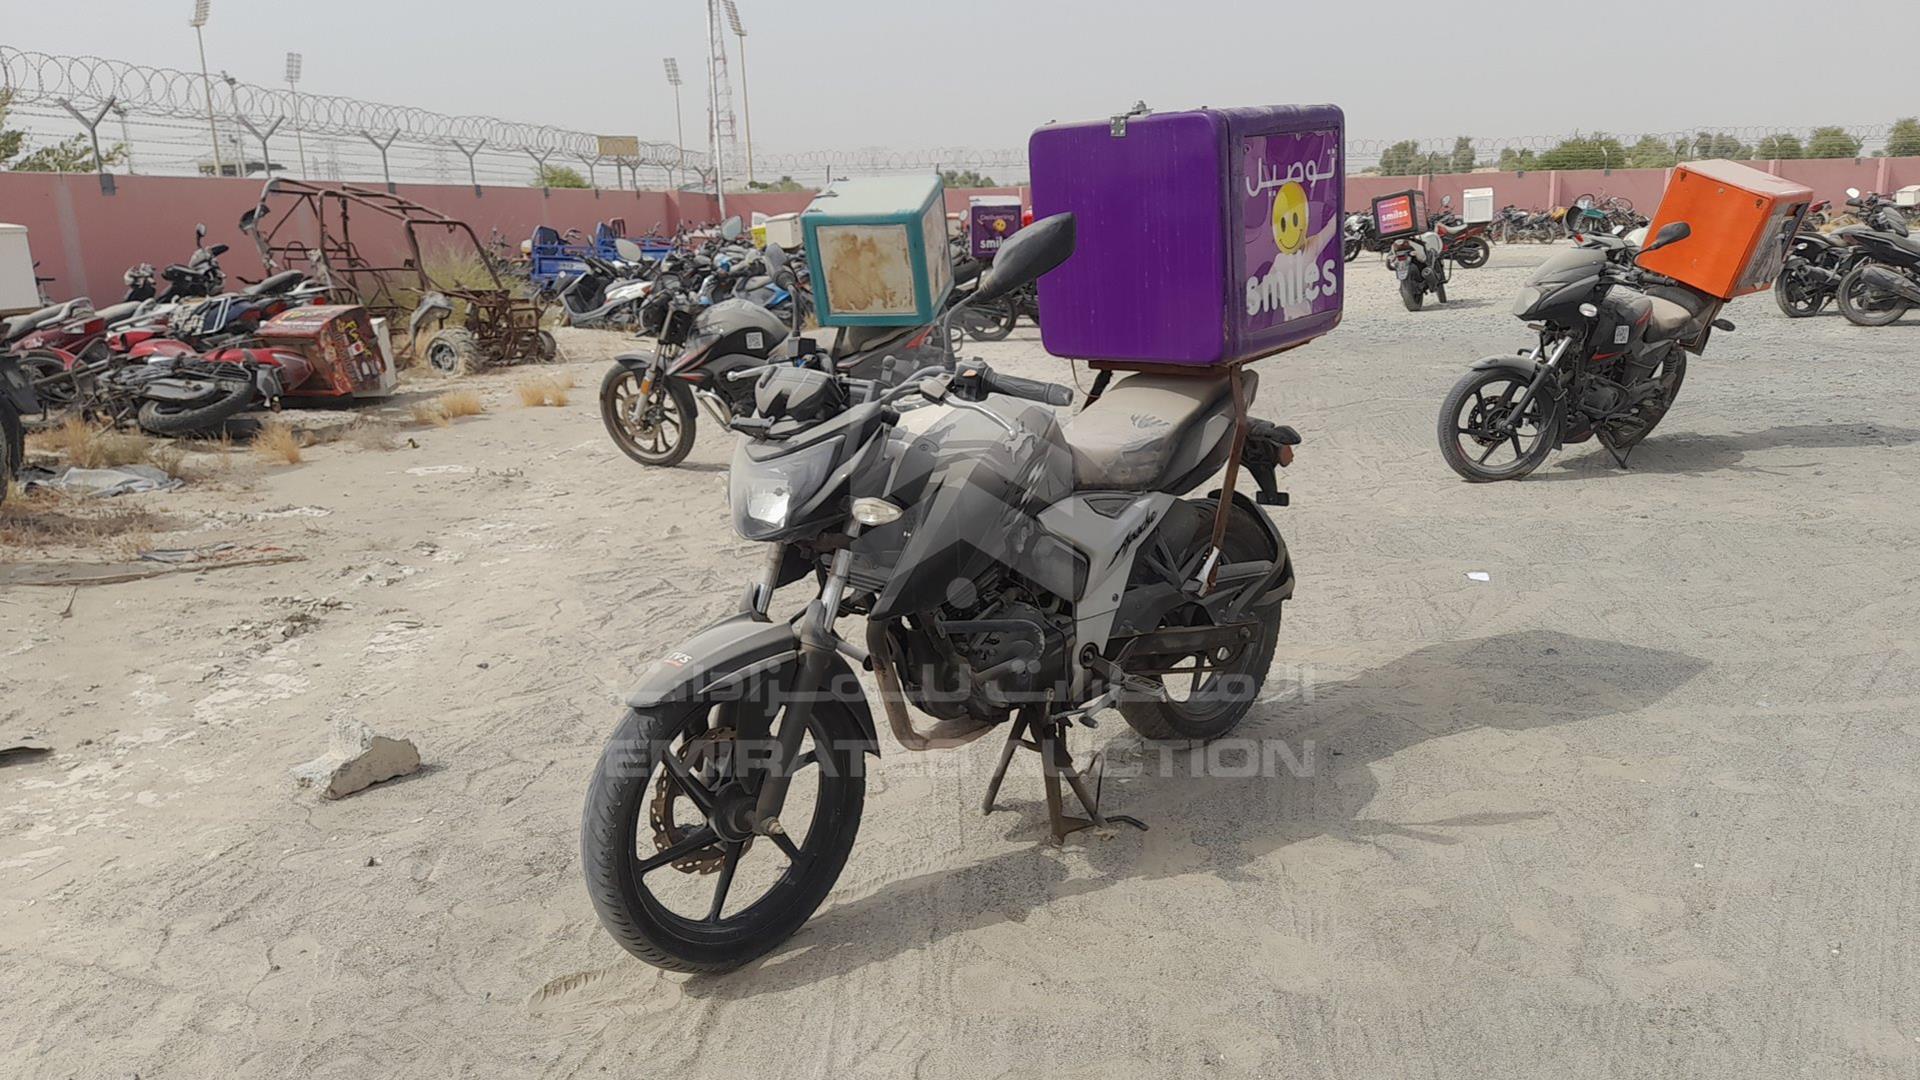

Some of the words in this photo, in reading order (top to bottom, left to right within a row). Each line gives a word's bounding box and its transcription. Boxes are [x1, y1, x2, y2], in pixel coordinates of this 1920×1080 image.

[1246, 144, 1337, 197] توصيل
[1381, 209, 1408, 221] smiles
[980, 235, 1004, 249] smil
[1246, 250, 1337, 316] smiles
